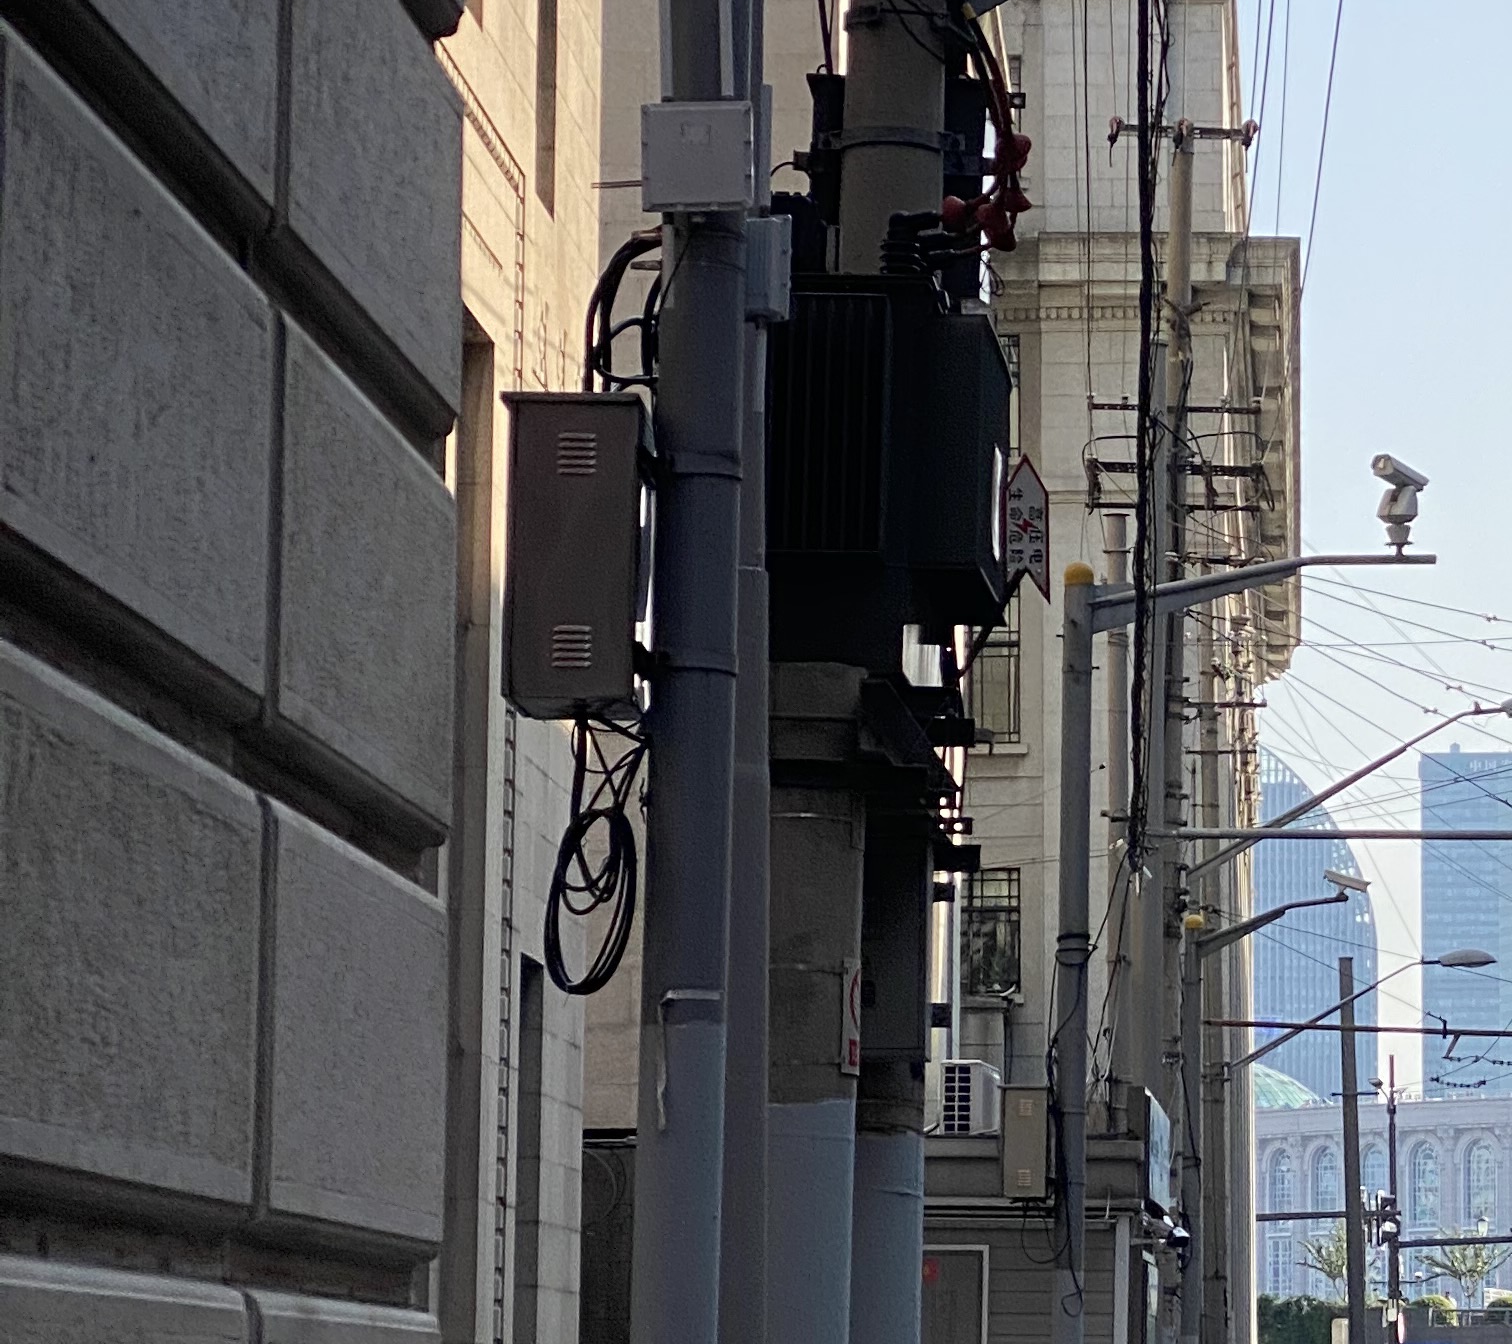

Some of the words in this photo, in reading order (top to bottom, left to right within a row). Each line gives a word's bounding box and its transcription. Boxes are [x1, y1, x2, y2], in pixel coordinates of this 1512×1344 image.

[1009, 487, 1024, 564] 生命危险
[1028, 506, 1043, 564] 高压电
